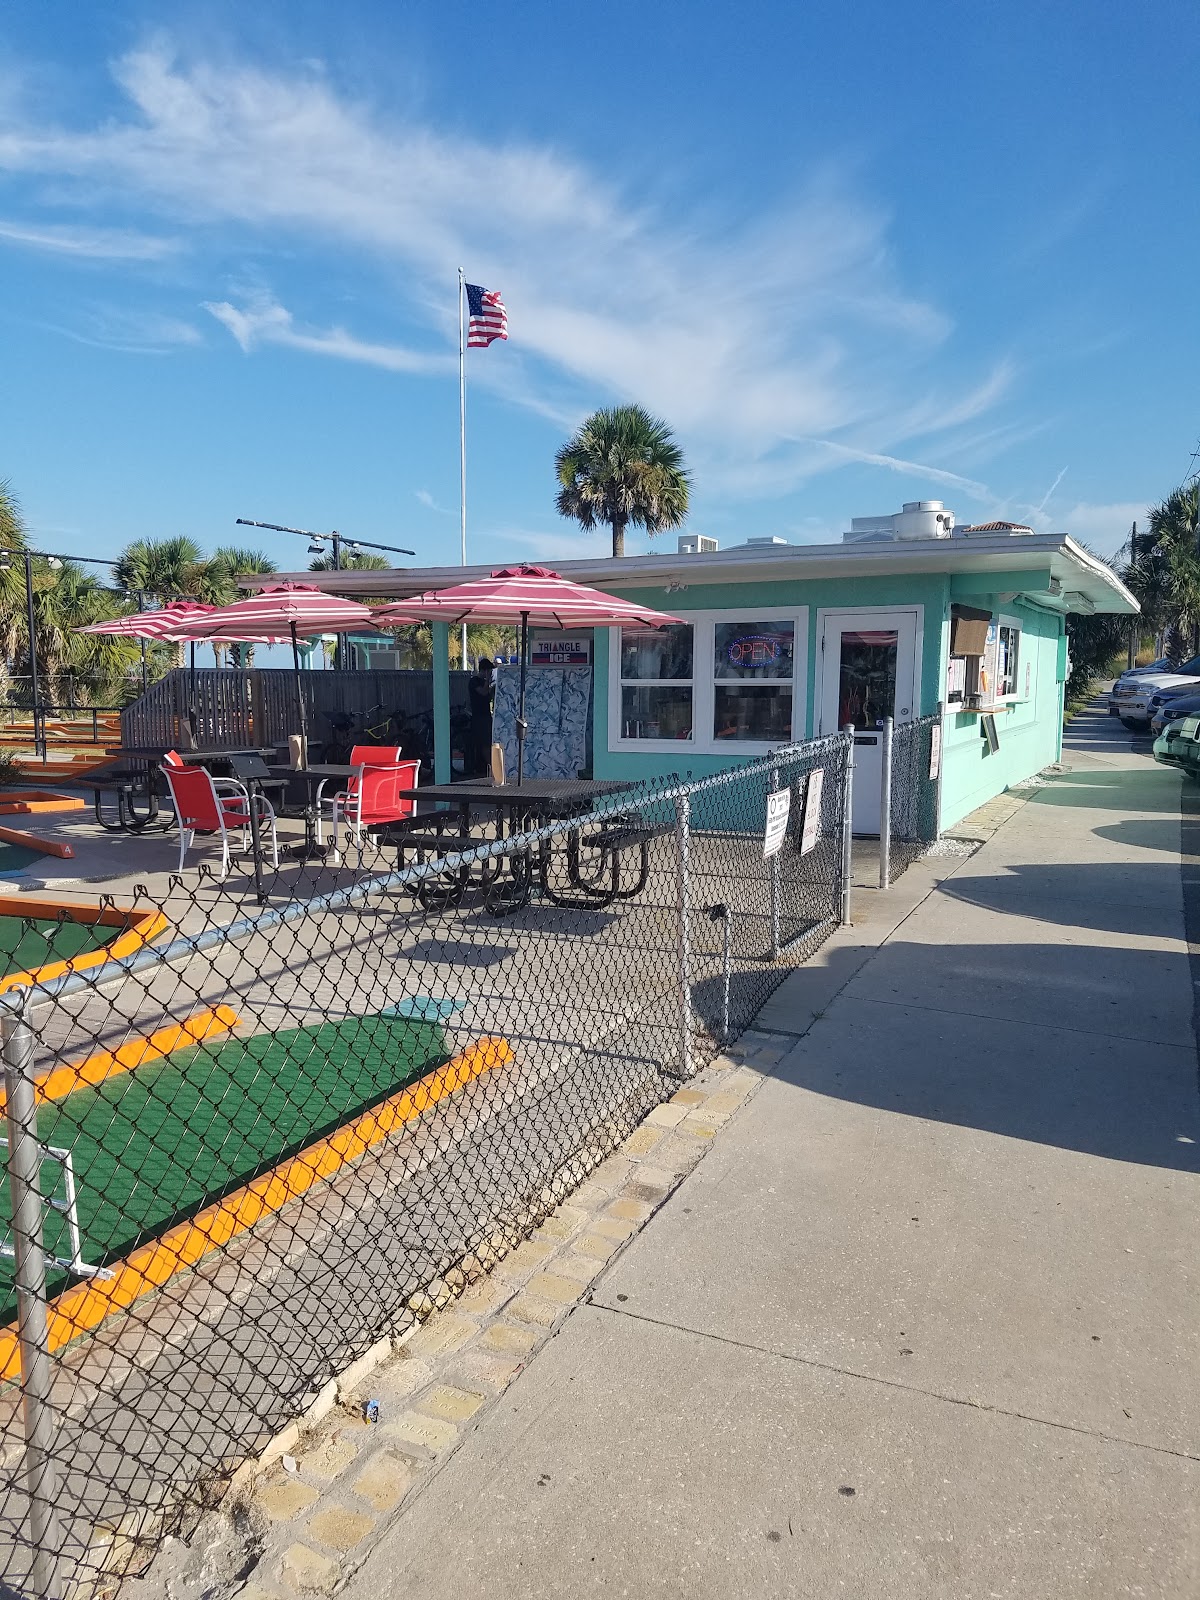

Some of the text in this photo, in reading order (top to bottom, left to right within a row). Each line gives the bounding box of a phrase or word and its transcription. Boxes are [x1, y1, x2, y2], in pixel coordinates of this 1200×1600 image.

[539, 642, 581, 652] TRIANGLE
[731, 642, 776, 660] OPEN
[549, 653, 570, 662] ICE
[64, 845, 71, 853] 4
